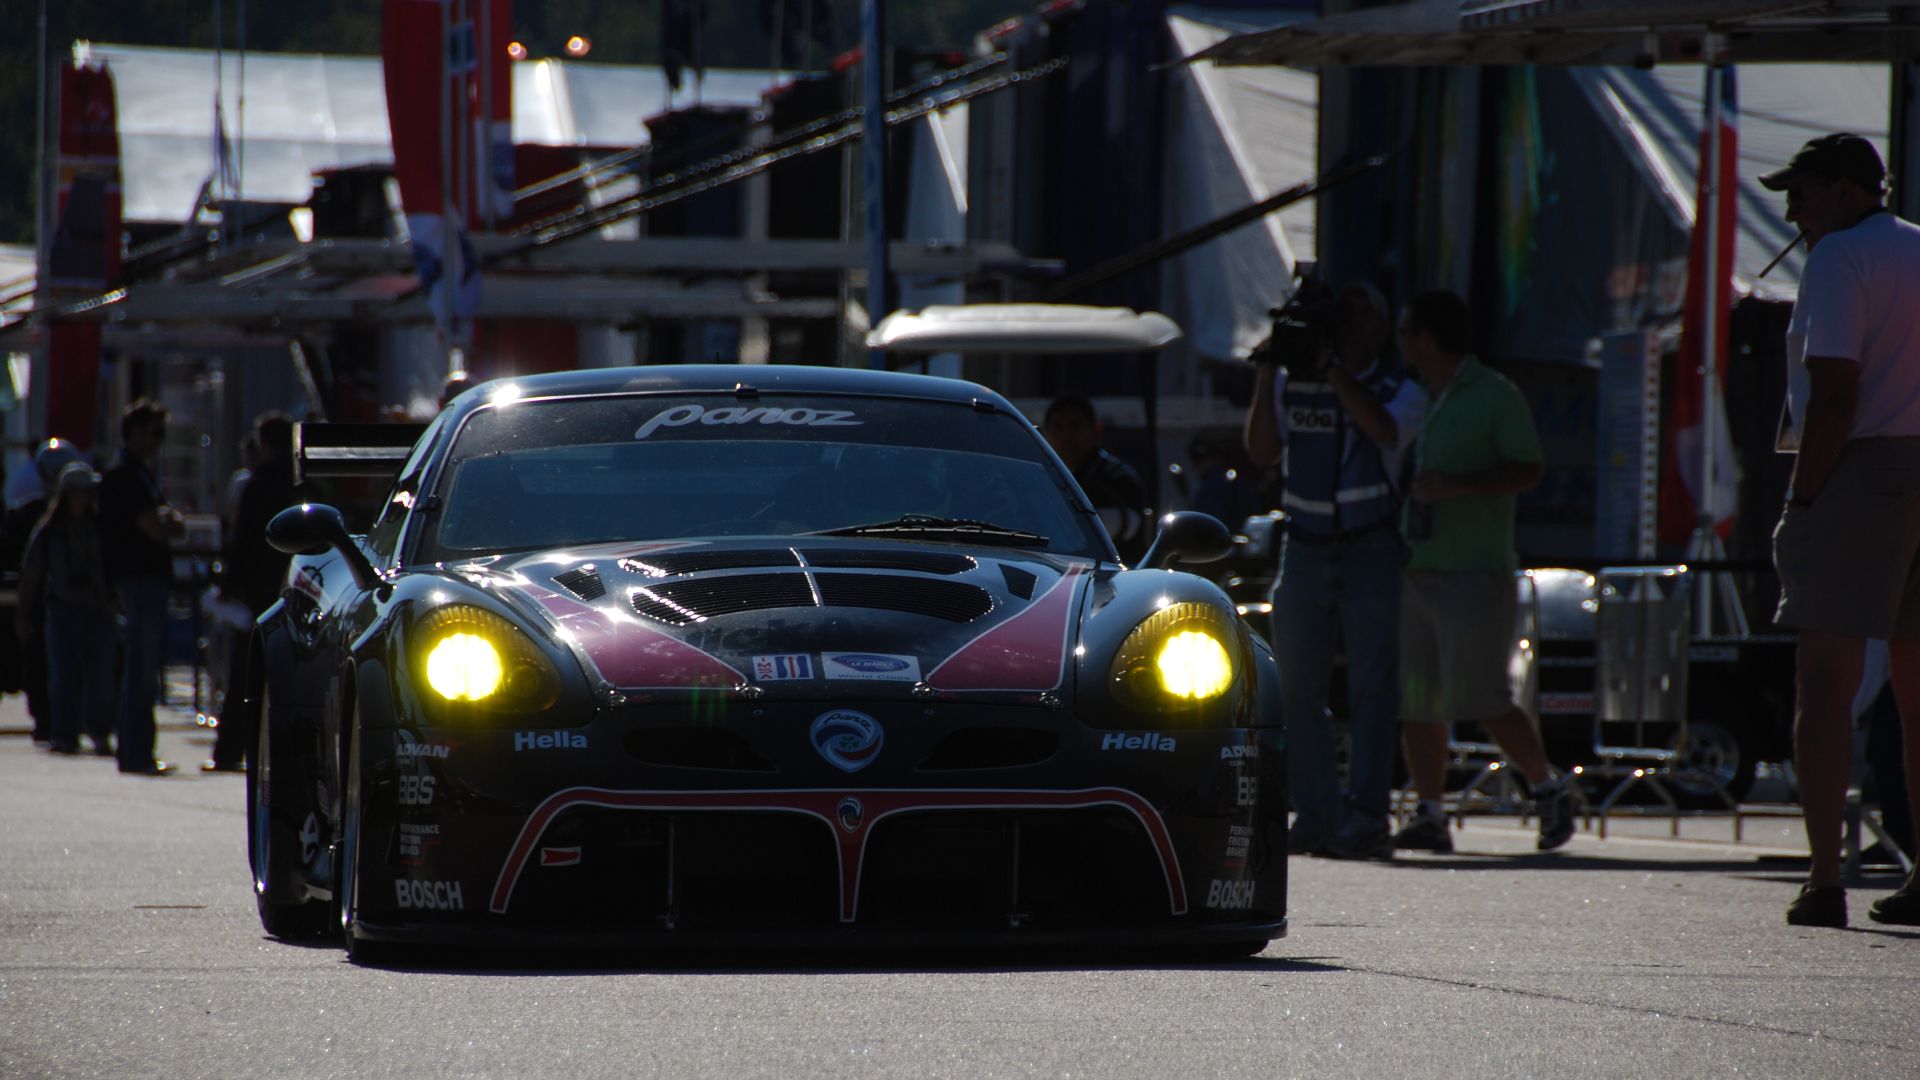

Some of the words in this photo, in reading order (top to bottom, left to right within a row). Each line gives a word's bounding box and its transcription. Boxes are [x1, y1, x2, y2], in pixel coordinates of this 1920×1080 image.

[396, 743, 451, 759] ADVAN
[514, 731, 588, 752] Hella
[1101, 732, 1177, 752] Hella
[398, 775, 436, 805] BBS
[394, 878, 465, 911] BOSCH
[1206, 879, 1256, 910] BOSCH
